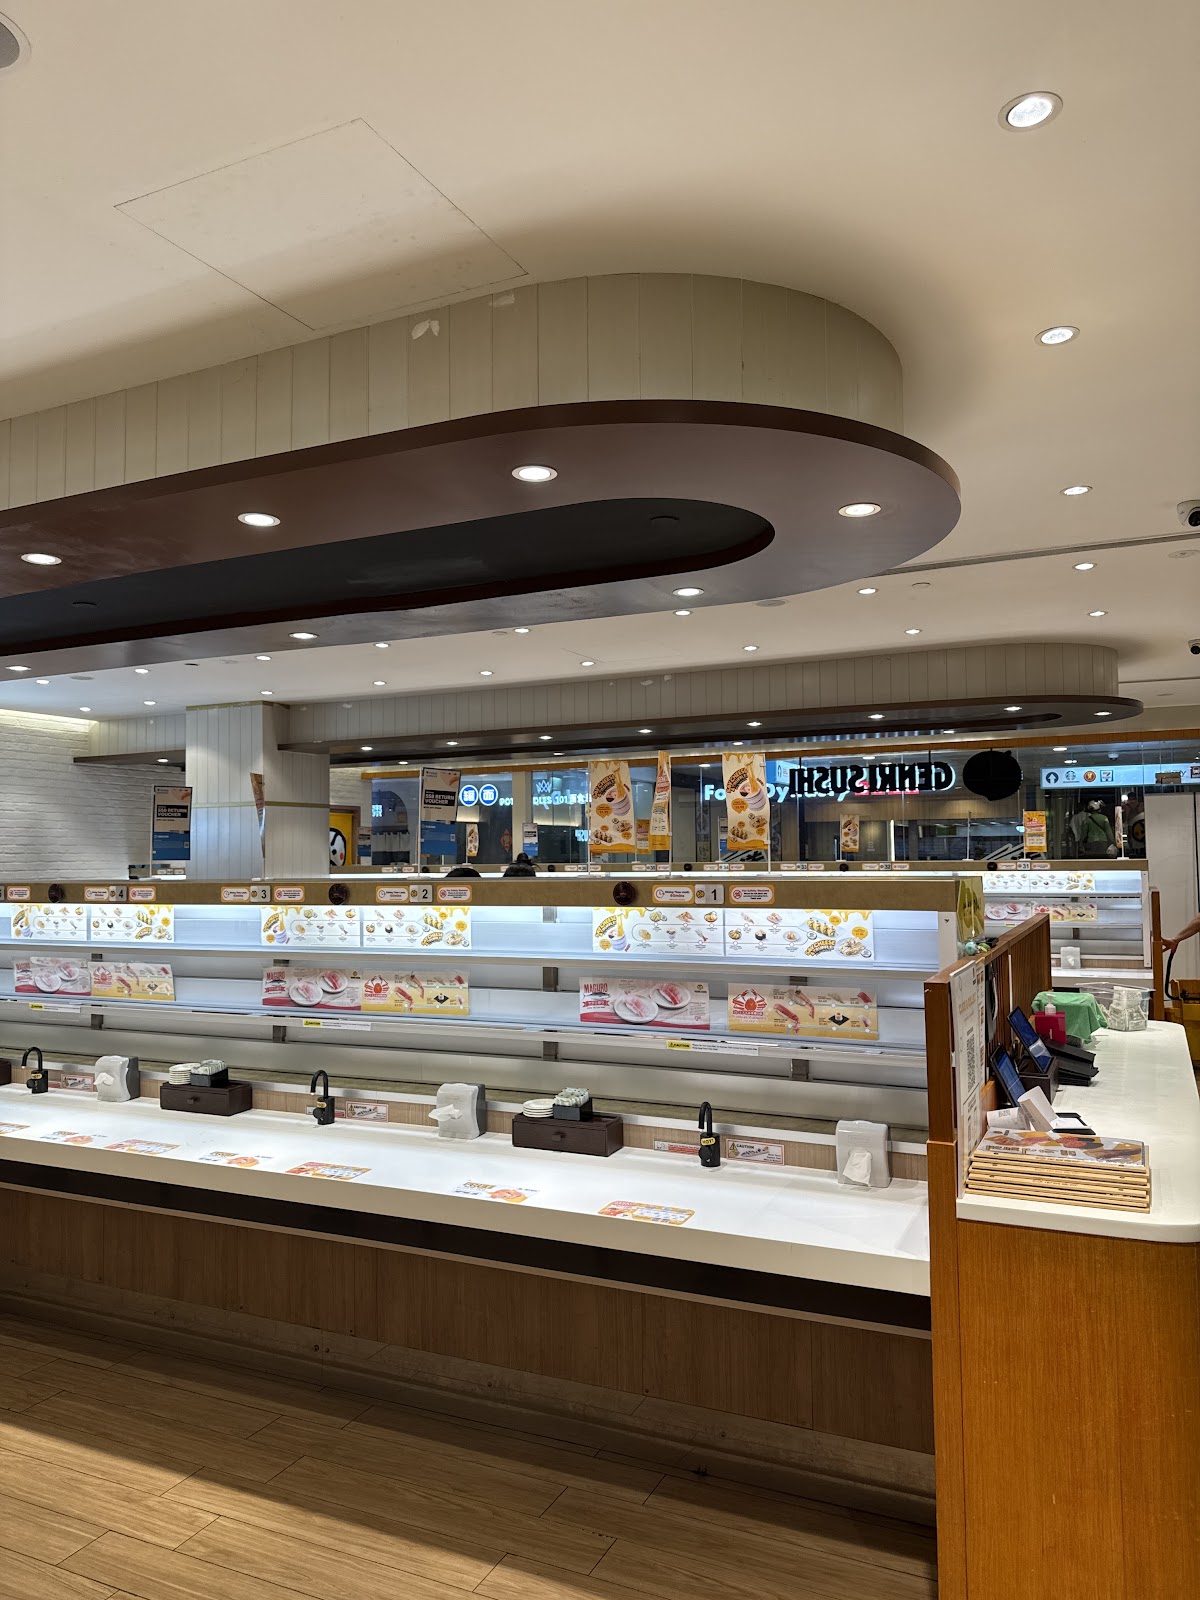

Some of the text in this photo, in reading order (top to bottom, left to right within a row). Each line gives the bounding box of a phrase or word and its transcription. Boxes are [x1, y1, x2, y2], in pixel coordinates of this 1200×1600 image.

[704, 784, 727, 800] Fo
[118, 889, 124, 899] 4
[261, 889, 267, 899] 3
[422, 888, 429, 899] 2
[711, 889, 717, 900] 1
[266, 971, 285, 980] MAGURO
[584, 983, 608, 993] MAGURO
